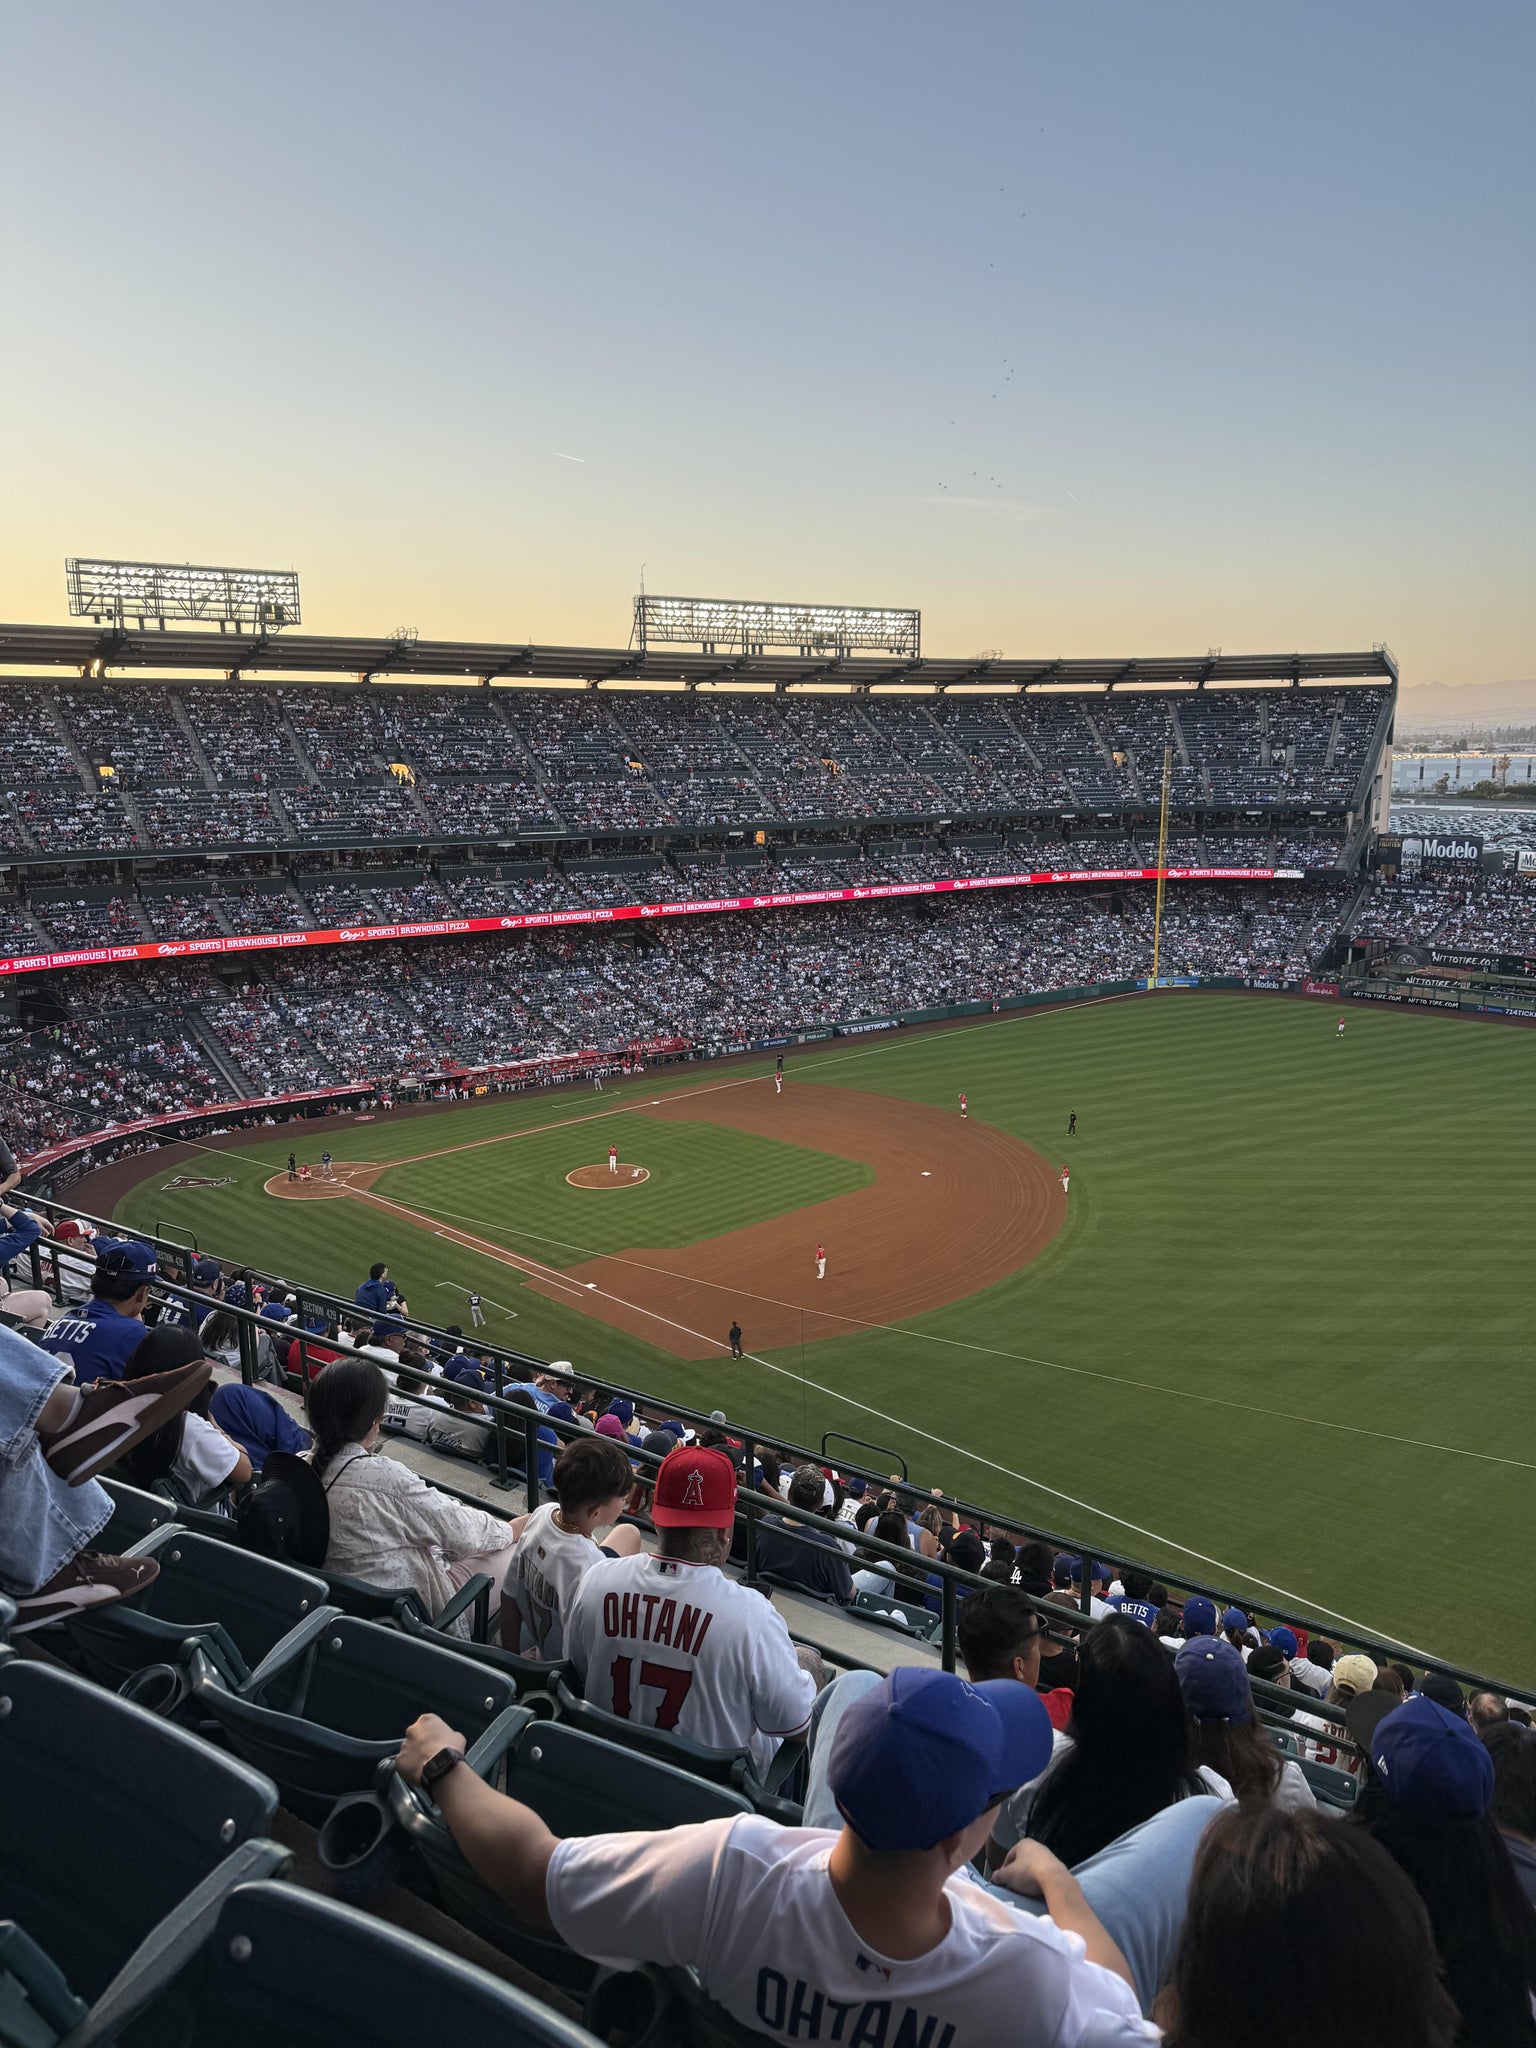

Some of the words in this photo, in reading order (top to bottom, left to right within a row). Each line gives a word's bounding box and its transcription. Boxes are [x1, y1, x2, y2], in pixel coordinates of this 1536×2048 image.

[1423, 839, 1478, 859] Modelo
[525, 915, 549, 924] SPORTS
[367, 927, 396, 937] SPORTS
[400, 924, 445, 934] BREWHOUSE
[449, 922, 470, 930] PIZZA
[158, 943, 186, 955] Oggi's
[189, 941, 221, 951] SPORTS
[227, 936, 279, 948] BREWHOUSE
[283, 934, 307, 944] PIZZA
[13, 957, 47, 970] SPORTS
[52, 950, 107, 965] BREWHOUSE
[112, 948, 138, 958] PIZZA
[1432, 953, 1493, 966] NITTOTIRE.CO
[1253, 979, 1279, 990] Modelo
[1408, 997, 1428, 1005] NITTO
[1429, 1000, 1459, 1009] TIRE.COM
[851, 1025, 863, 1033] MLB
[863, 1021, 890, 1031] NETWORK
[628, 1042, 658, 1051] SALINAS,
[156, 1249, 174, 1264] SECTION
[302, 1301, 325, 1317] SECTION
[42, 1319, 97, 1344] BETTS
[682, 1470, 704, 1506] A
[1010, 1566, 1022, 1585] LA
[1121, 1602, 1149, 1618] BETTS
[603, 1592, 714, 1657] OHTANI
[610, 1655, 693, 1731] 17
[757, 1966, 956, 2048] OHTANI
